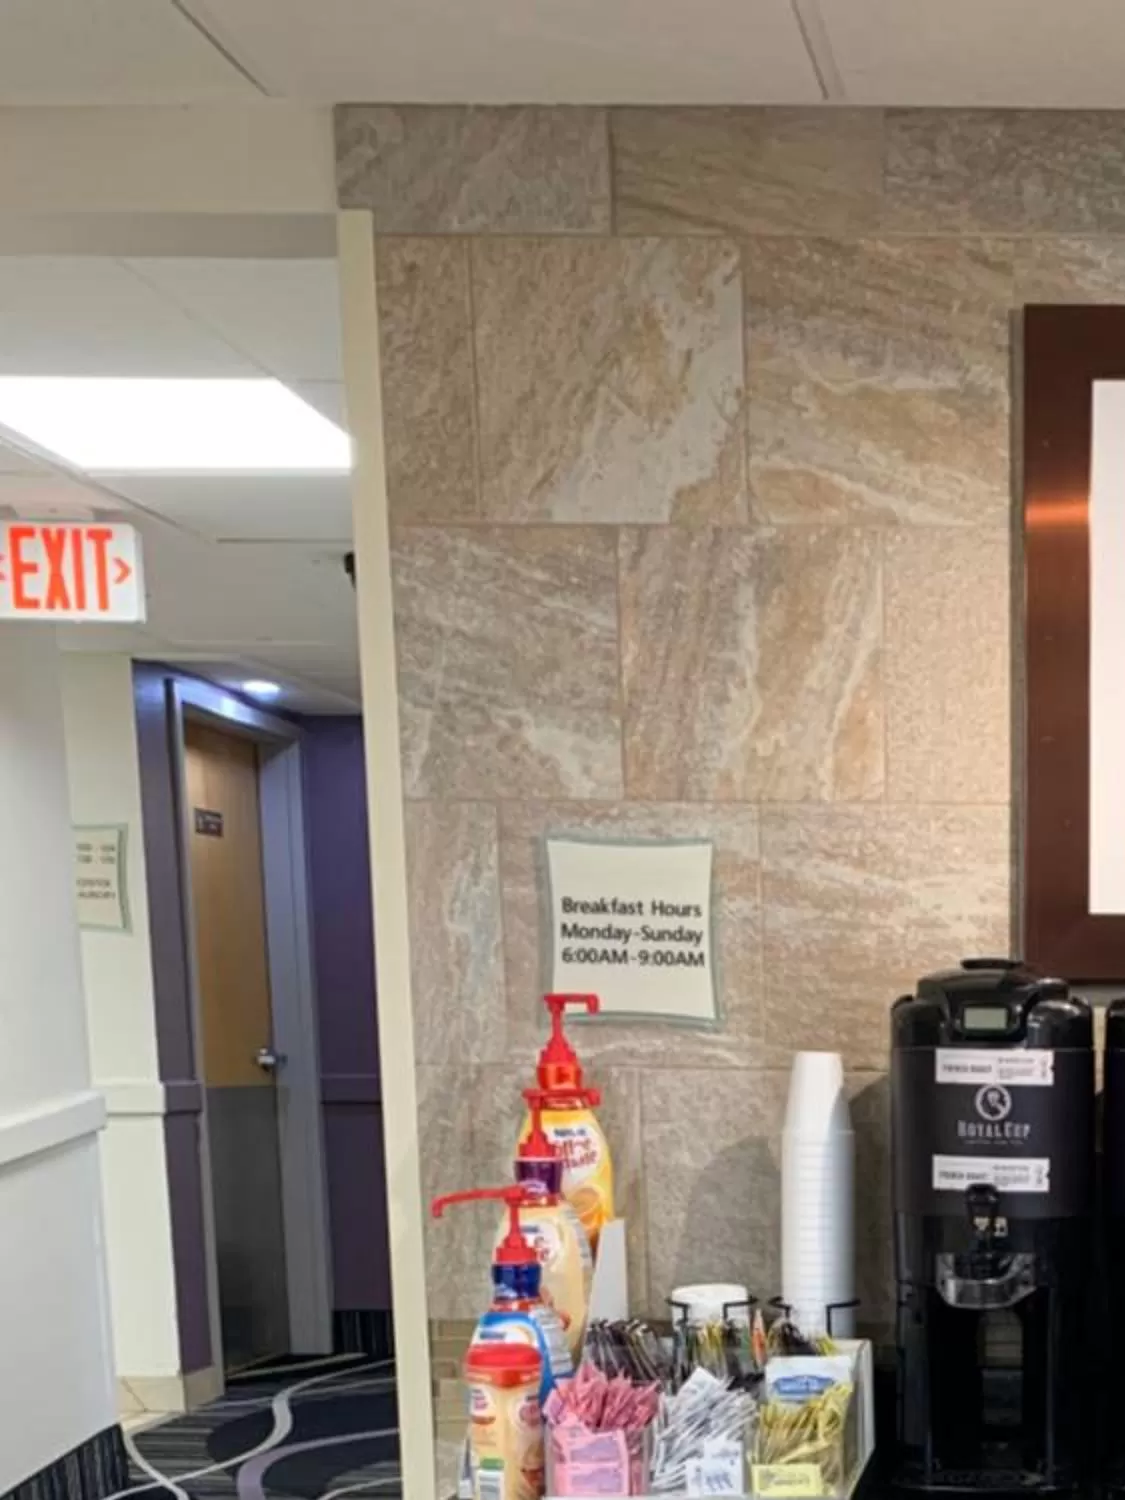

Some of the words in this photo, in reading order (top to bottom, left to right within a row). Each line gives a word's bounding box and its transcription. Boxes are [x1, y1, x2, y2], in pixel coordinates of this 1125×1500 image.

[10, 527, 113, 611] EXIT
[561, 897, 644, 915] Breakfast
[651, 900, 702, 917] Hours
